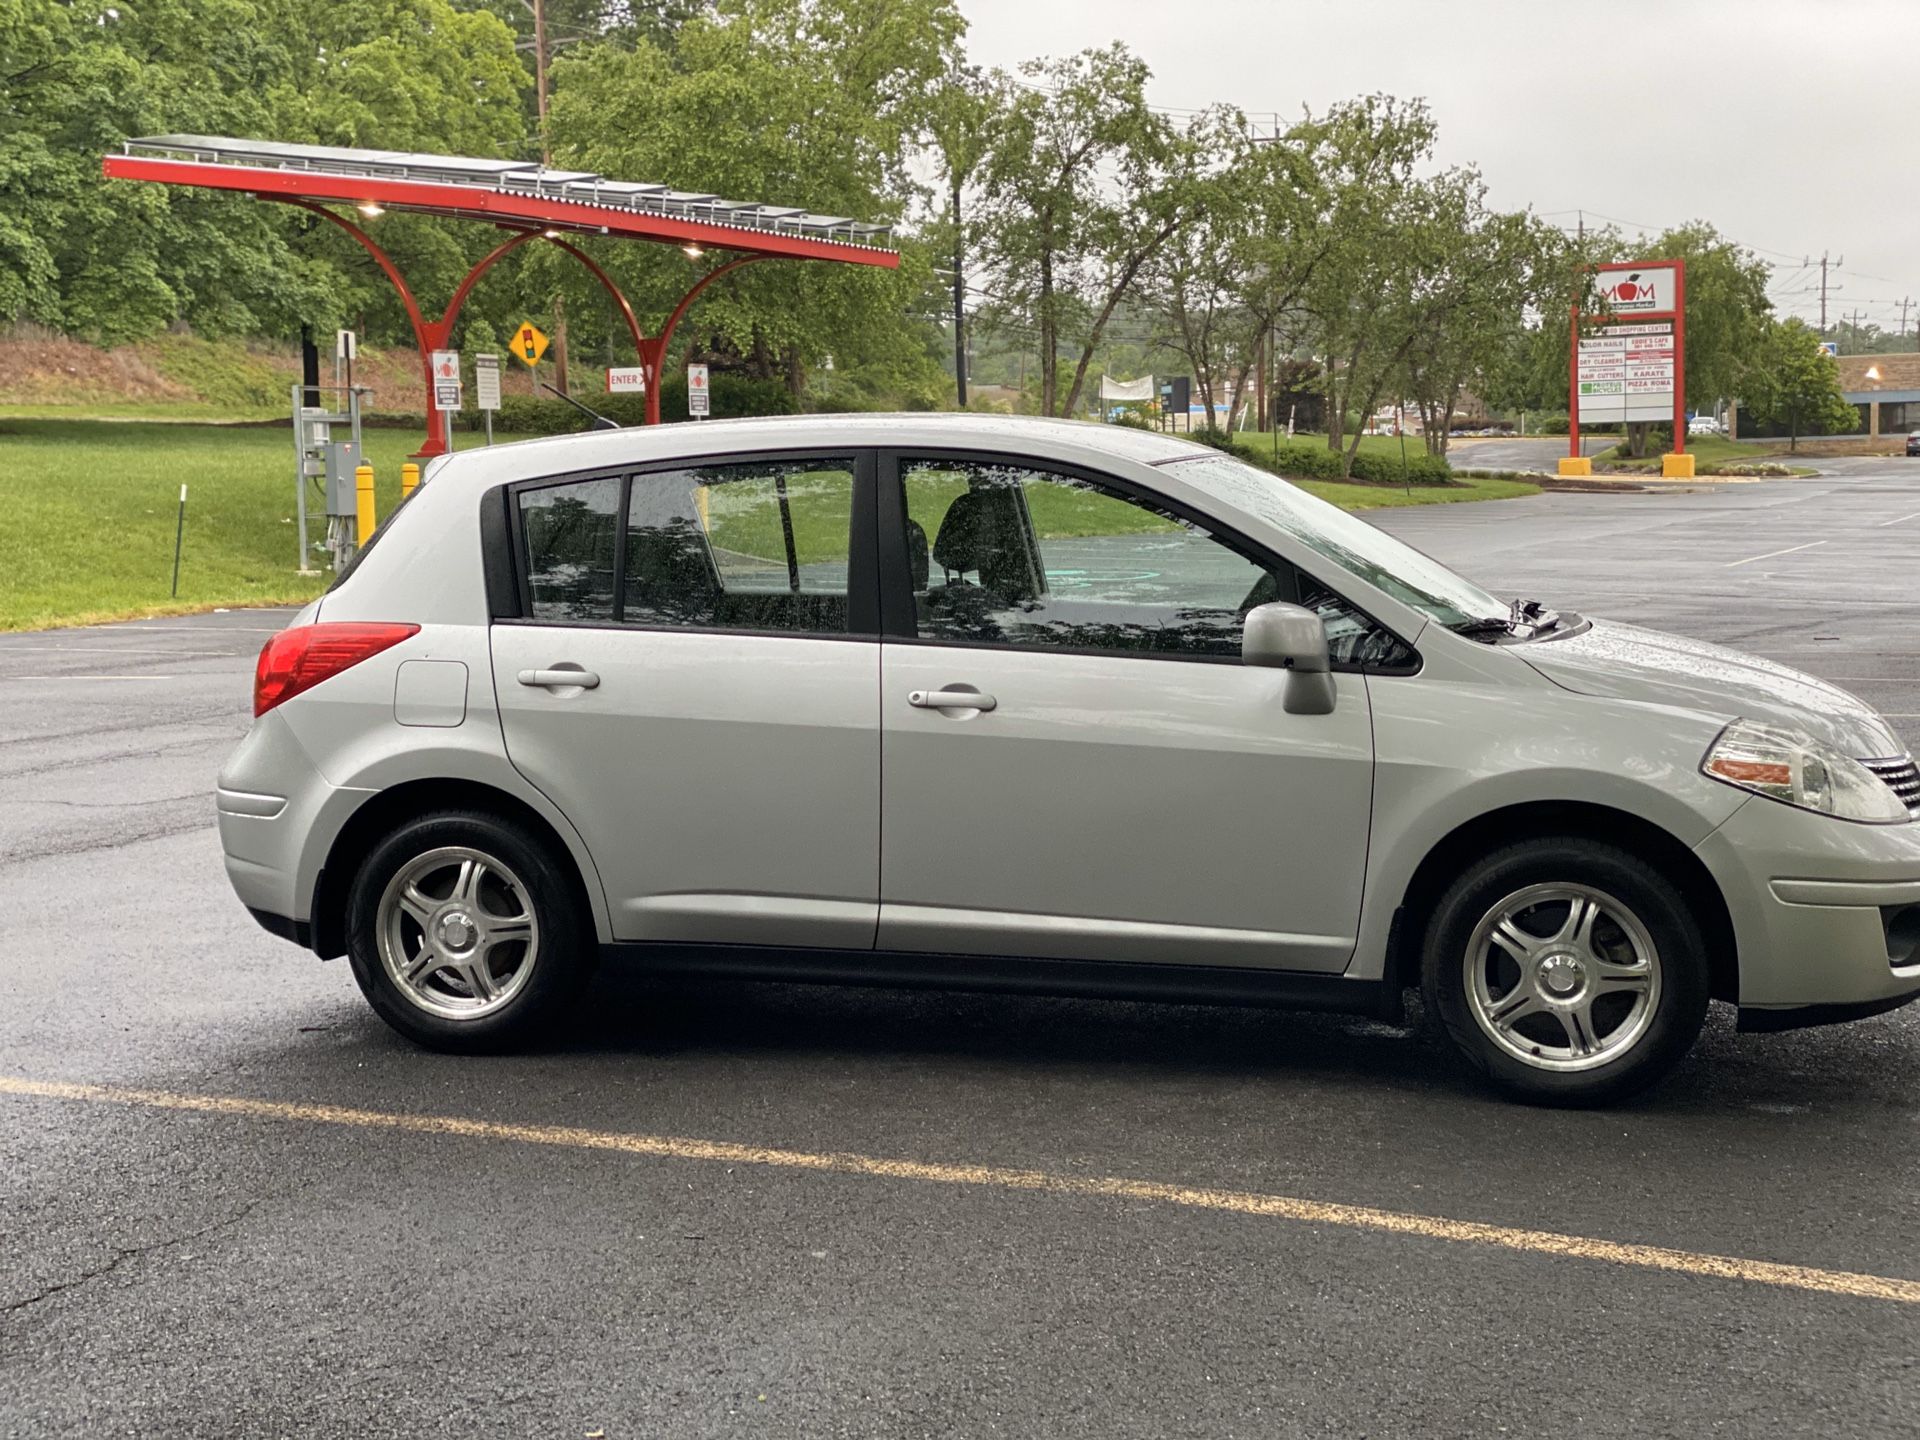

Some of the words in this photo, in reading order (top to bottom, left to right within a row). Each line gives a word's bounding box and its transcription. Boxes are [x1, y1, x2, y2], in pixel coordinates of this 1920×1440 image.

[1619, 326, 1646, 334] SHOPPING
[1647, 324, 1668, 332] CENTER
[1593, 357, 1623, 365] CLEANERS
[1633, 370, 1665, 378] KARATE
[611, 375, 638, 385] ENTER
[1627, 380, 1648, 388] PIZZA
[1650, 379, 1671, 387] ROMA
